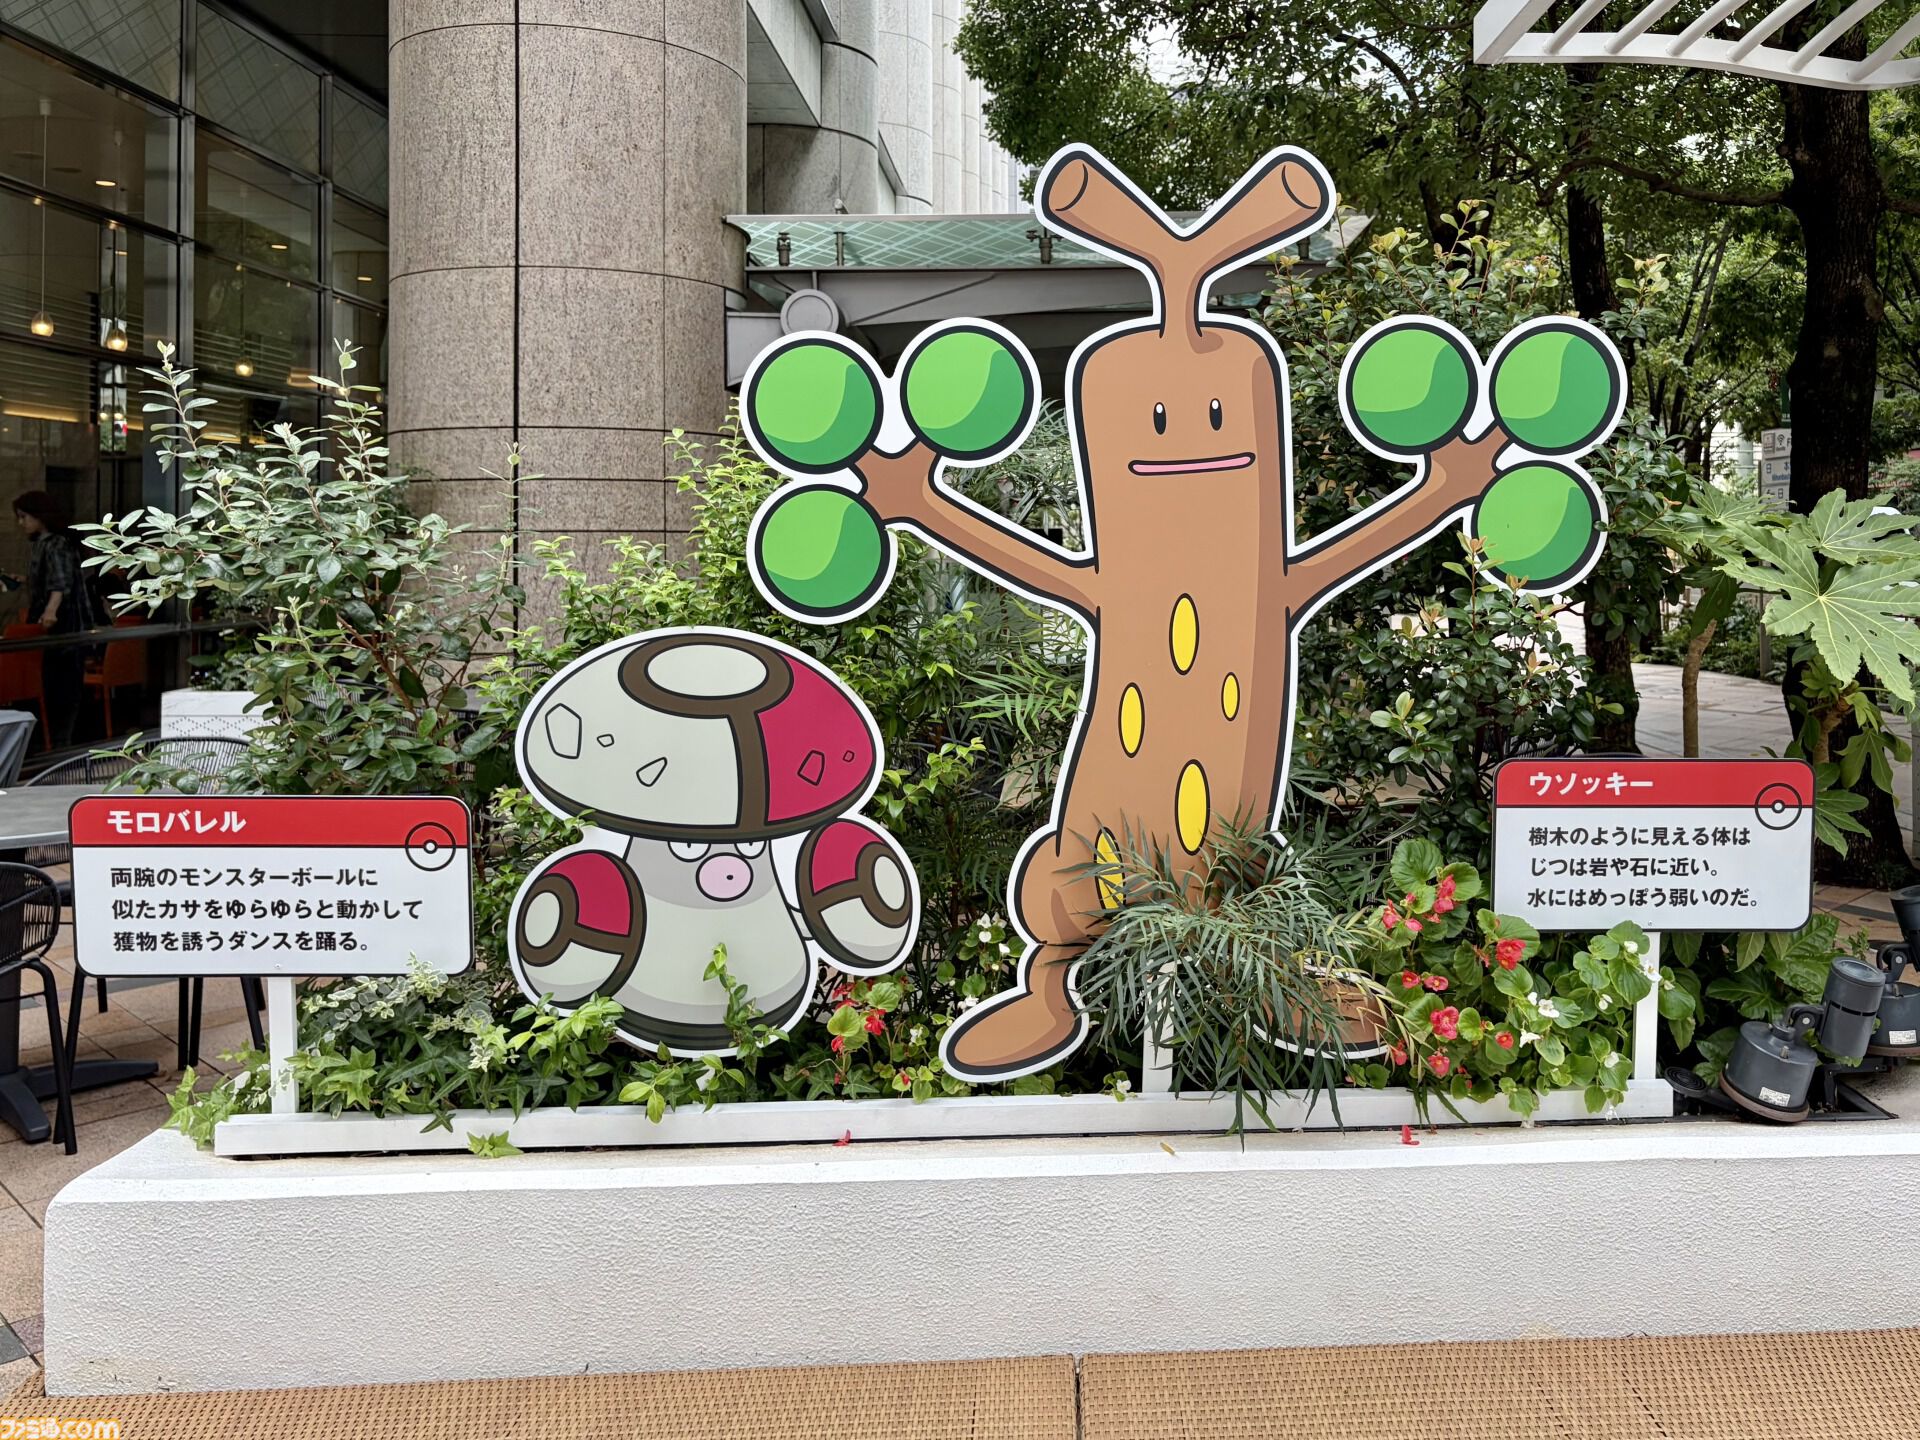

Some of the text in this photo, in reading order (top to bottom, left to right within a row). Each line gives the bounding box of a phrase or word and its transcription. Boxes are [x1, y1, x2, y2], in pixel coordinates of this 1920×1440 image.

[1530, 772, 1653, 795] ウソッキー
[108, 810, 246, 833] モロバレル
[1529, 827, 1750, 846] 樹木のように見える体は
[111, 867, 377, 887] 両腕のモンスターボールに
[1532, 858, 1717, 876] じつは岩や石に近い。
[1528, 888, 1756, 907] 水にはめっぽう弱いのだ。
[112, 899, 422, 919] 似たカサをゆらゆらと動かして
[113, 931, 367, 951] 獲物を誘うダンスを踊る。
